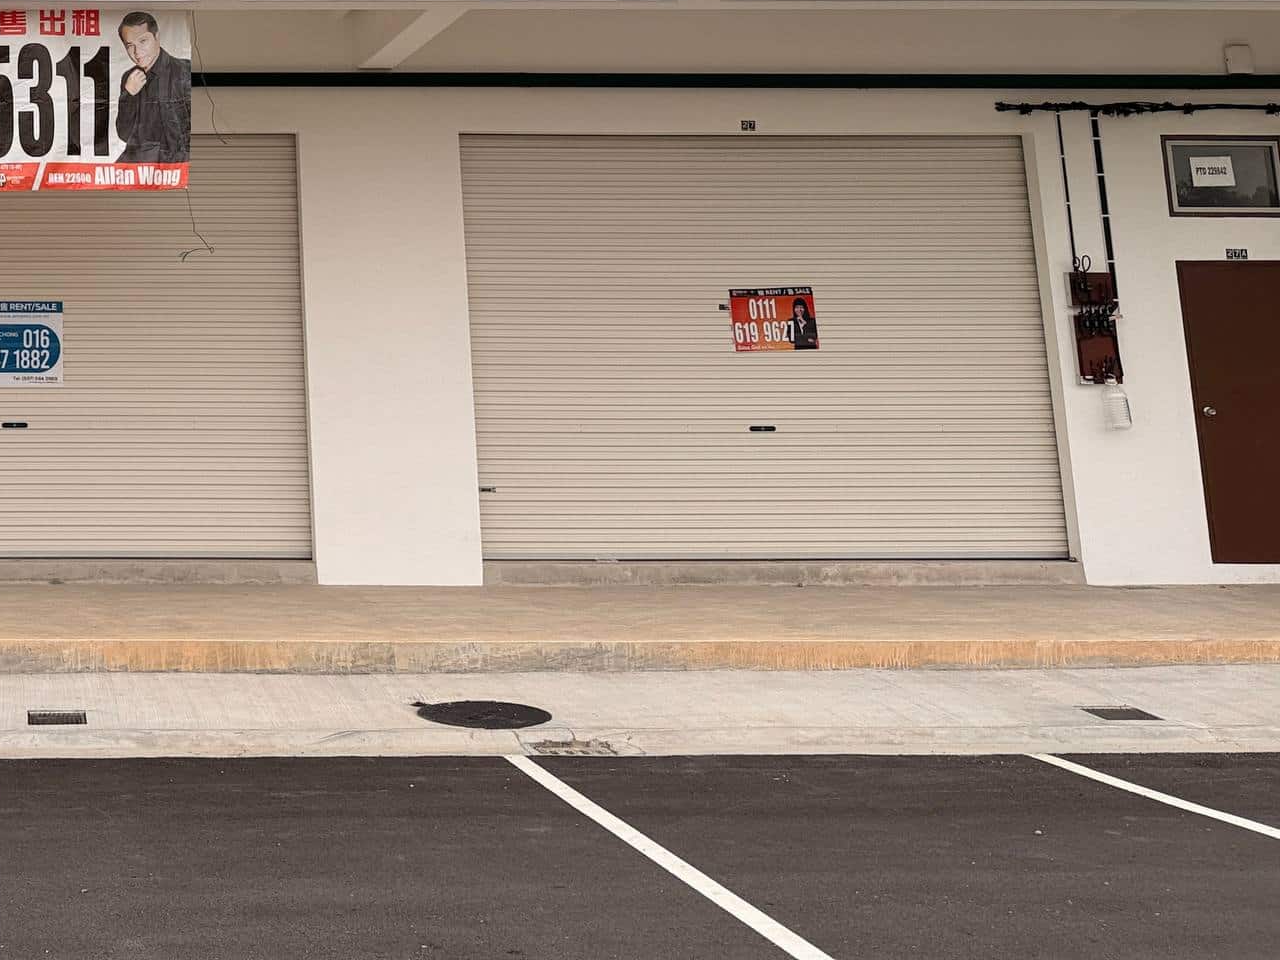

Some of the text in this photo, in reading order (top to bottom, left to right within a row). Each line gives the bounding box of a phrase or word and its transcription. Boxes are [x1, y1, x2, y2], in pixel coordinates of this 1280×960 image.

[94, 166, 134, 185] Allan
[138, 166, 181, 186] Wong
[1226, 249, 1248, 259] 27A
[9, 303, 57, 311] RENT/SALE
[748, 299, 777, 319] 0111
[23, 329, 50, 348] 016
[734, 321, 759, 343] 619
[13, 349, 50, 368] 1882
